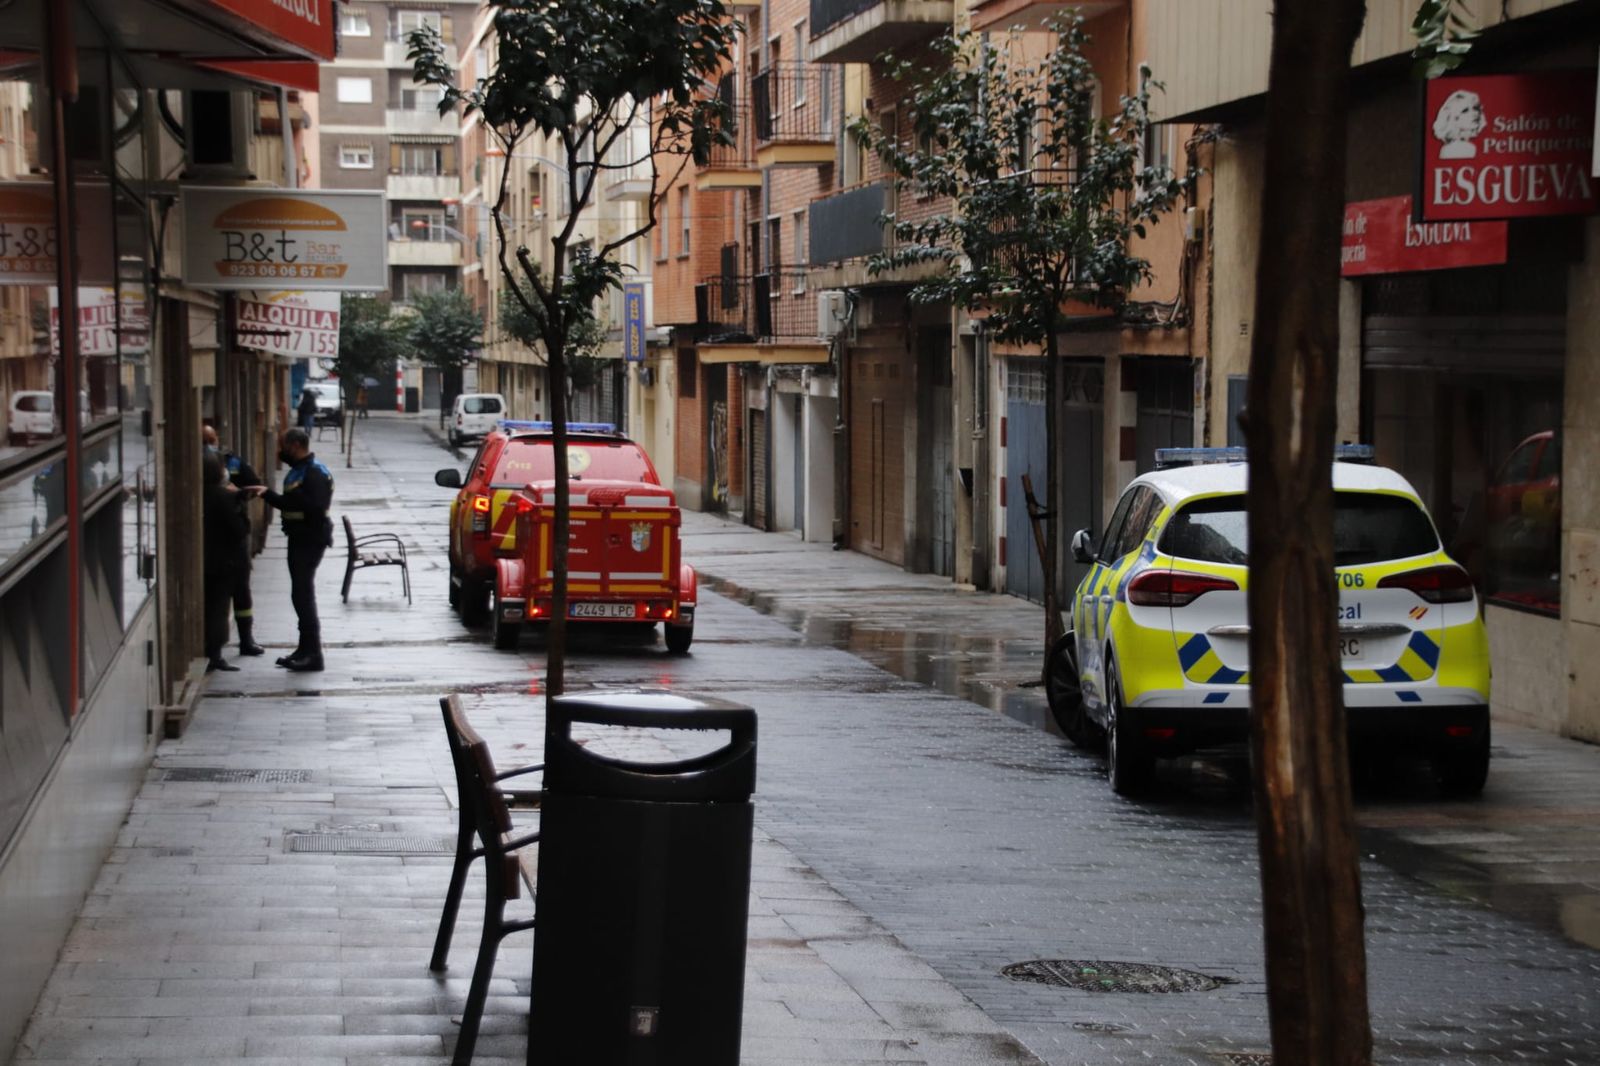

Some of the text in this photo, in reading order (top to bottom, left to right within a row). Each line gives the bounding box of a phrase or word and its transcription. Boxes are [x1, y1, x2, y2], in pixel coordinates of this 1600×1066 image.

[1492, 112, 1584, 134] Salón de
[1433, 162, 1592, 206] ESGUEVA
[220, 230, 342, 263] B&t Bar
[230, 264, 316, 277] 923 06 06 67
[243, 302, 333, 330] ALQUILA
[309, 332, 337, 354] 155
[576, 604, 634, 616] 2449 LPC
[1336, 602, 1361, 619] cal
[1339, 638, 1359, 656] RC
